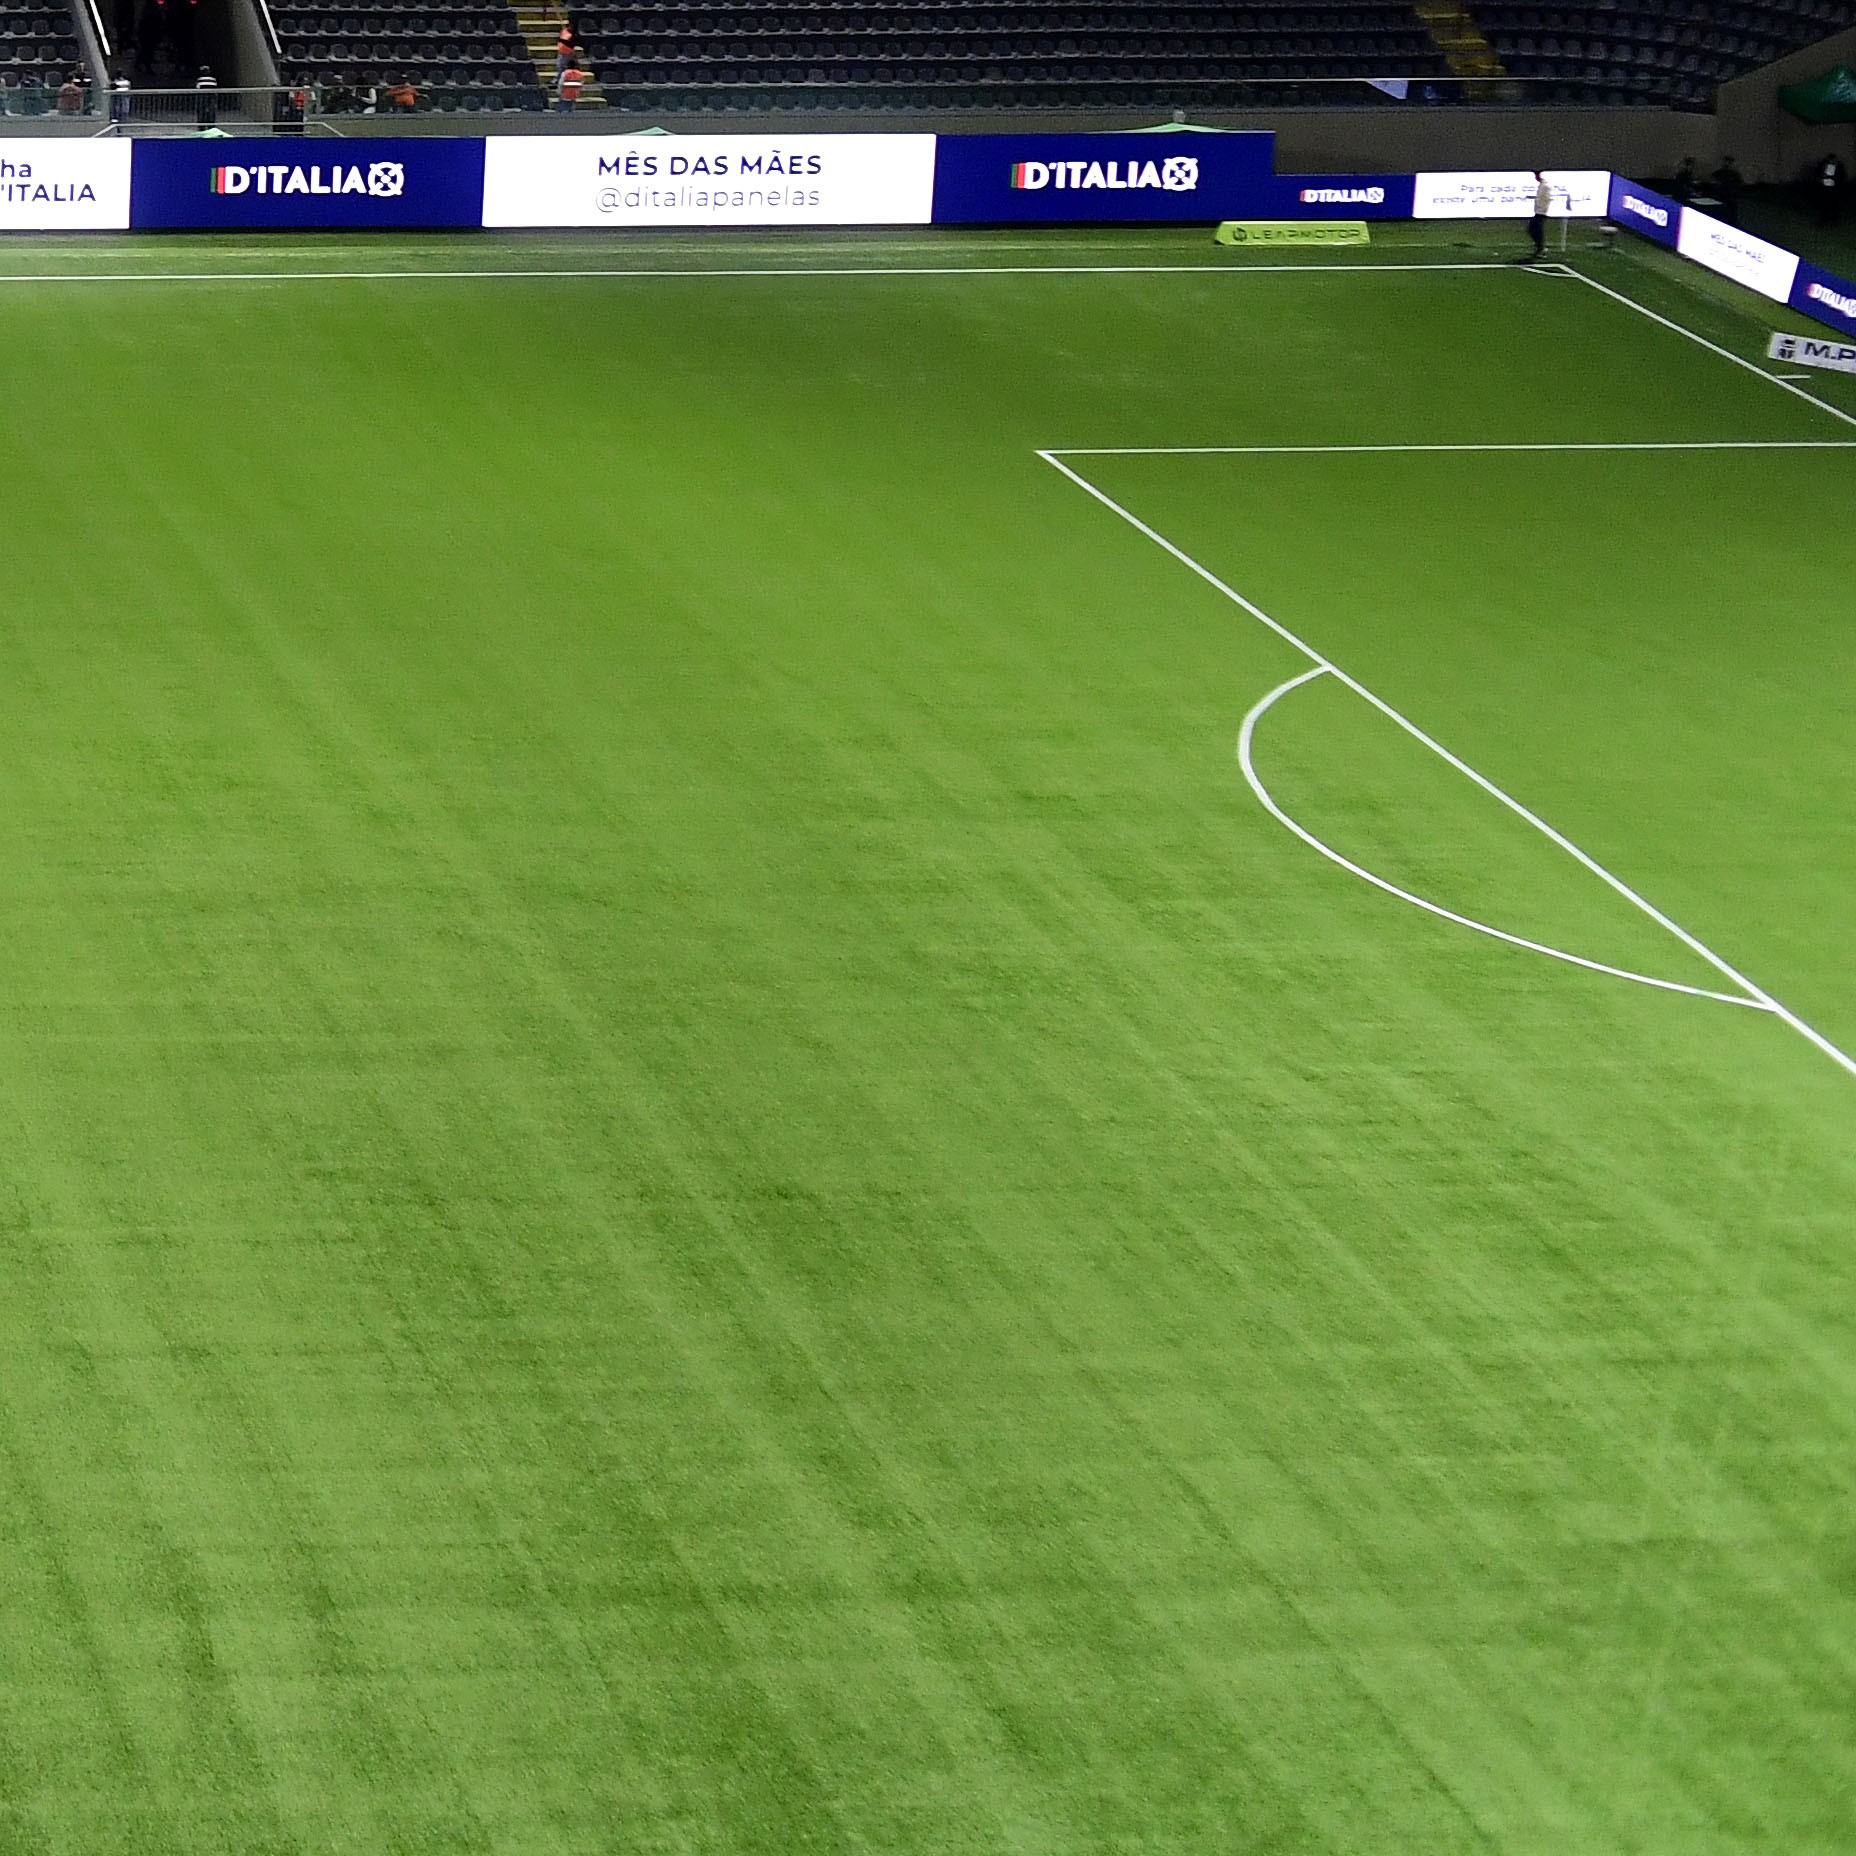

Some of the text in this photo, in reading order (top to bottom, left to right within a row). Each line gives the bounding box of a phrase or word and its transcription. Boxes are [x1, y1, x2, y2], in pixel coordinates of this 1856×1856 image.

[598, 149, 822, 177] MÊS DAS MÃES
[1024, 160, 1164, 190] D'ITALIA
[224, 165, 367, 194] D'ITALIA
[595, 185, 820, 214] @ditaliapanelas
